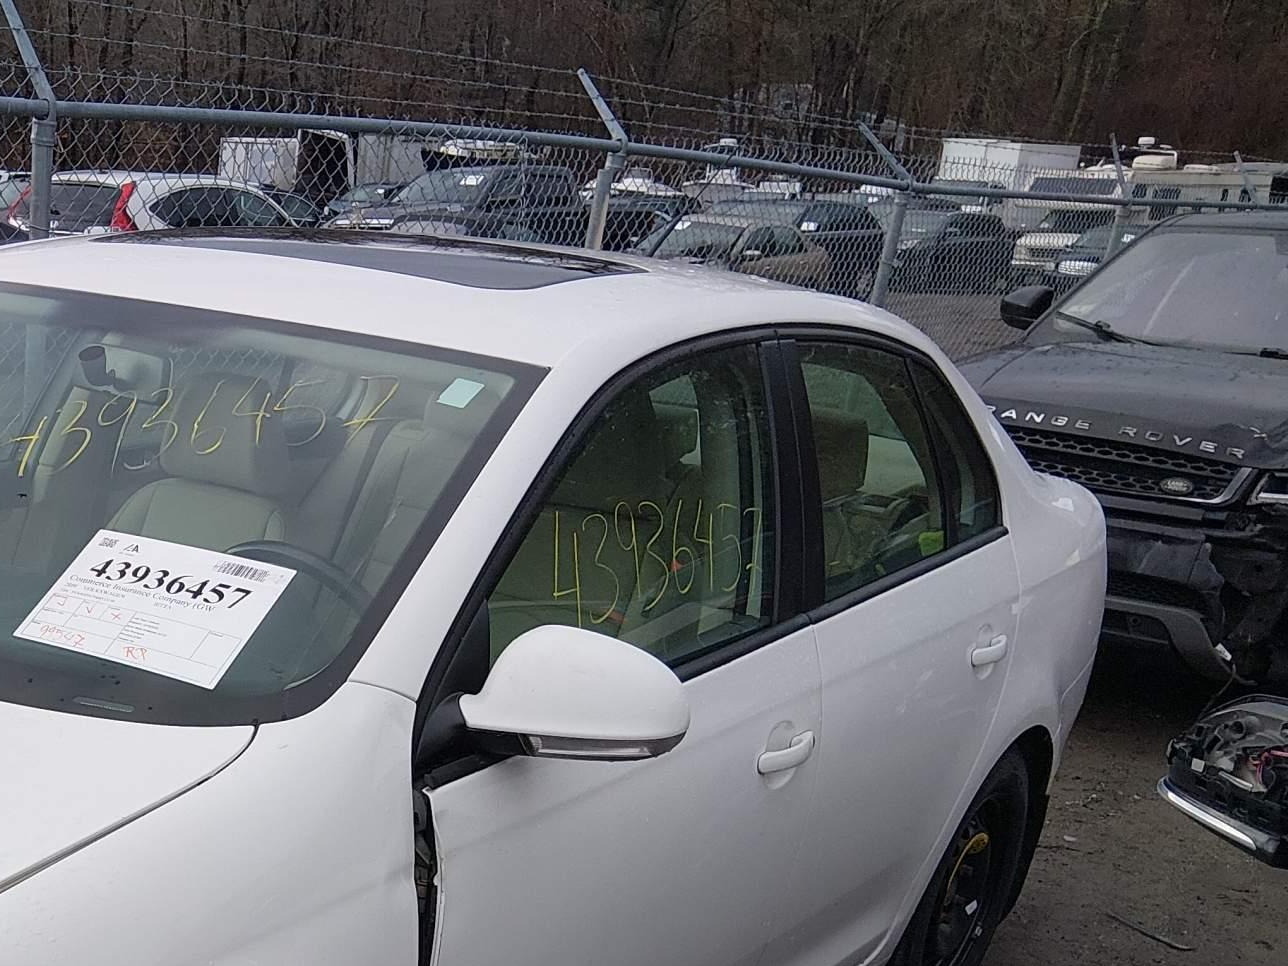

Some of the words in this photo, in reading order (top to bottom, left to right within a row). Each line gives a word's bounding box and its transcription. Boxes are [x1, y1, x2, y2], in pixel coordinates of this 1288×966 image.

[1118, 425, 1248, 459] ROVER
[88, 558, 253, 610] 43936457
[552, 498, 763, 629] 43936457
[69, 574, 111, 590] Commerce
[112, 583, 152, 598] Insurance
[152, 592, 192, 608] Company
